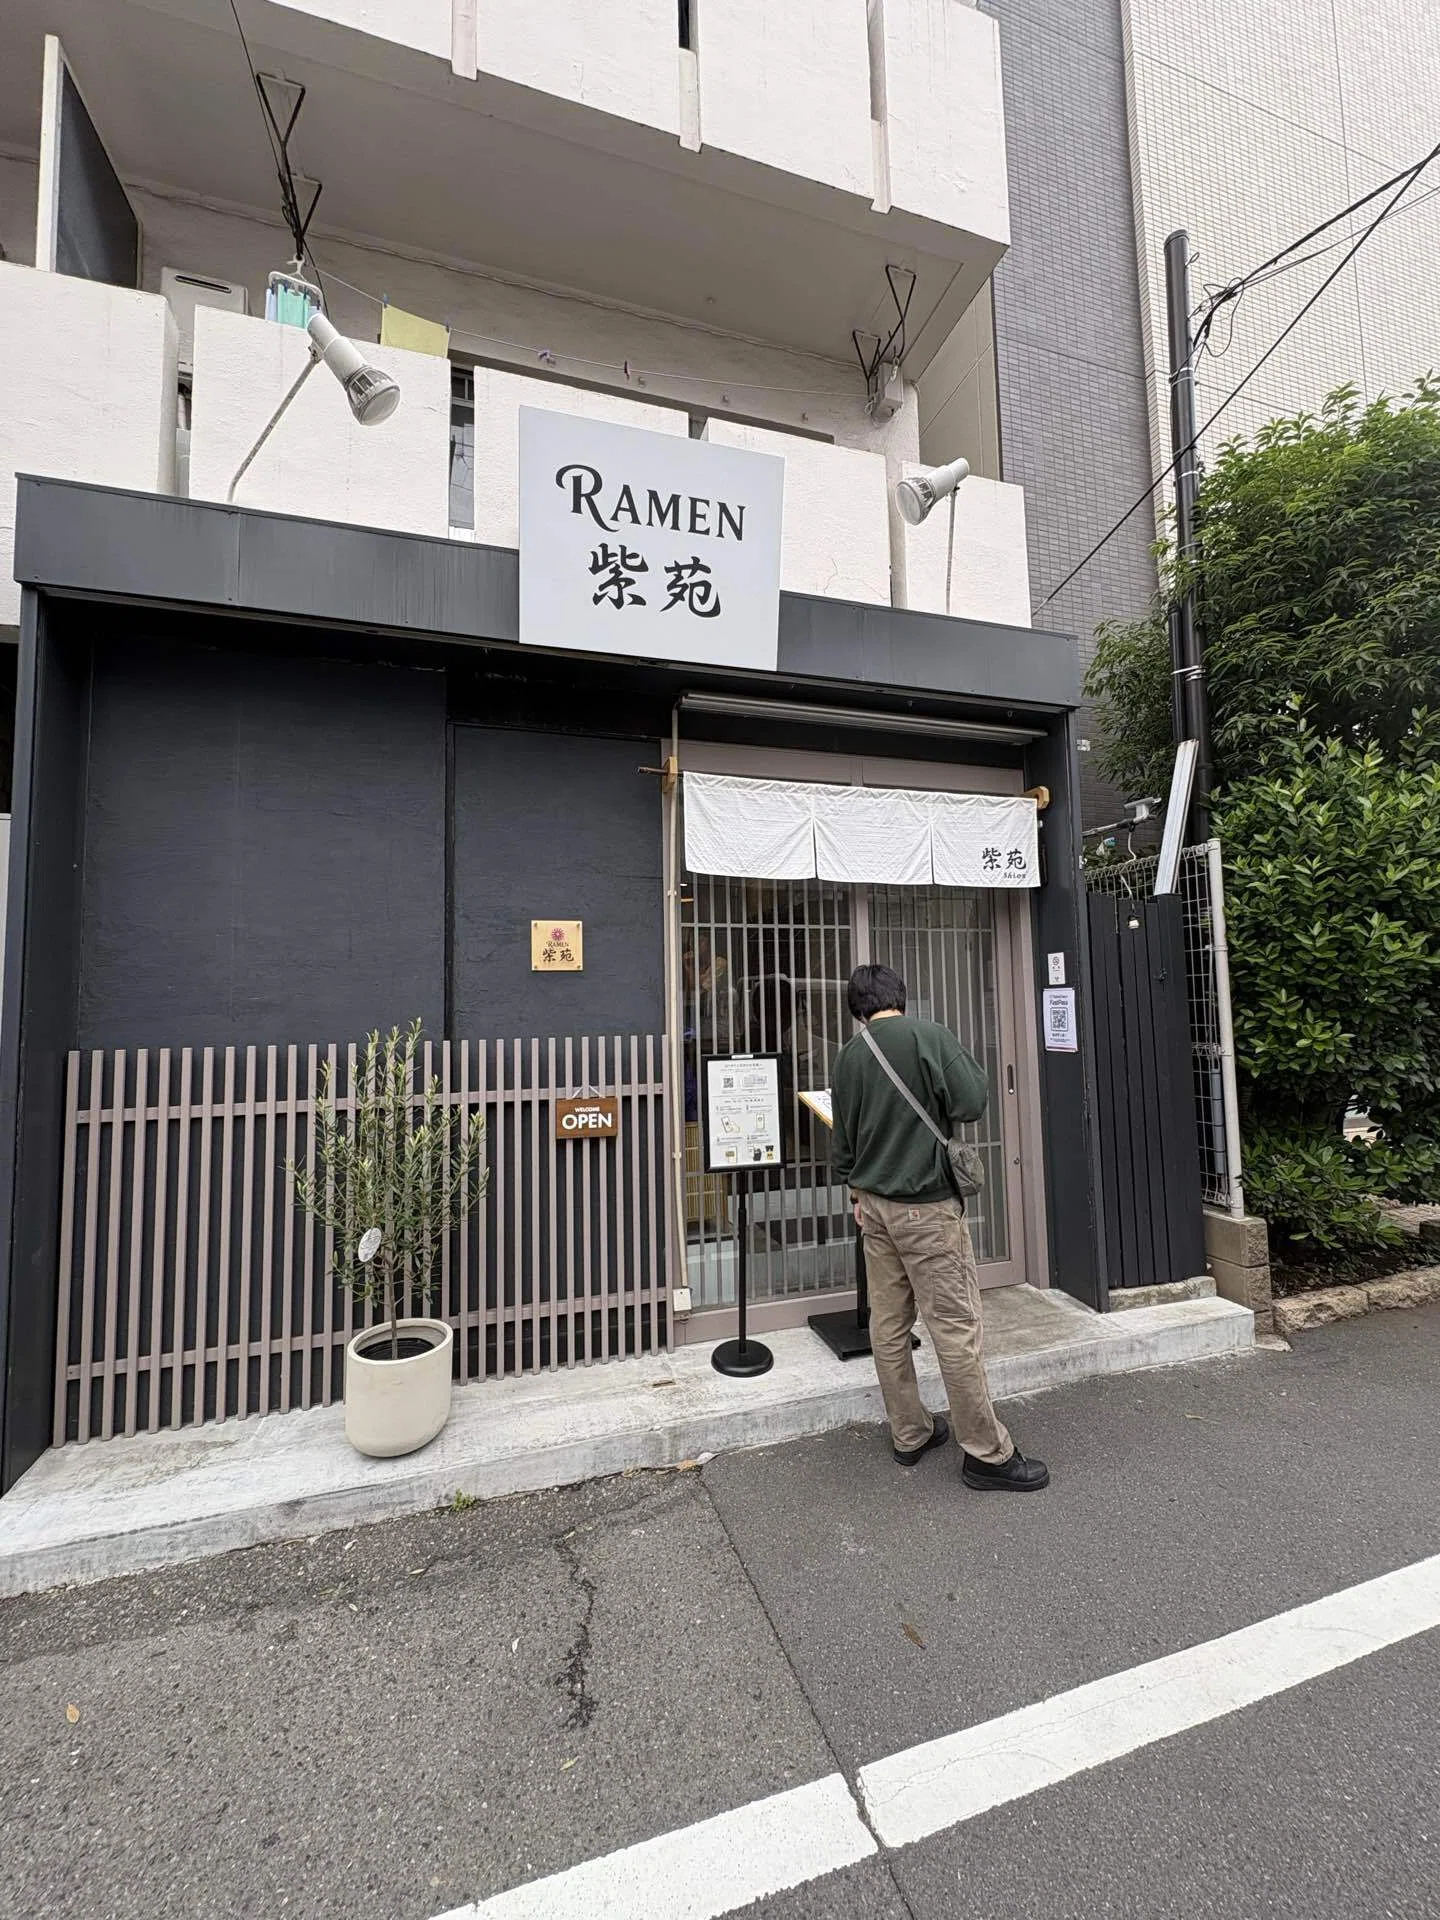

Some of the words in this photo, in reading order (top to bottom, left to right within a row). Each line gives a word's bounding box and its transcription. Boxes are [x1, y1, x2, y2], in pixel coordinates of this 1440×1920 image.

[556, 464, 746, 542] RAMEN
[588, 543, 721, 618] 紫苑
[982, 847, 1027, 871] 紫苑
[542, 948, 574, 962] 紫苑
[562, 1112, 612, 1130] OPEN
